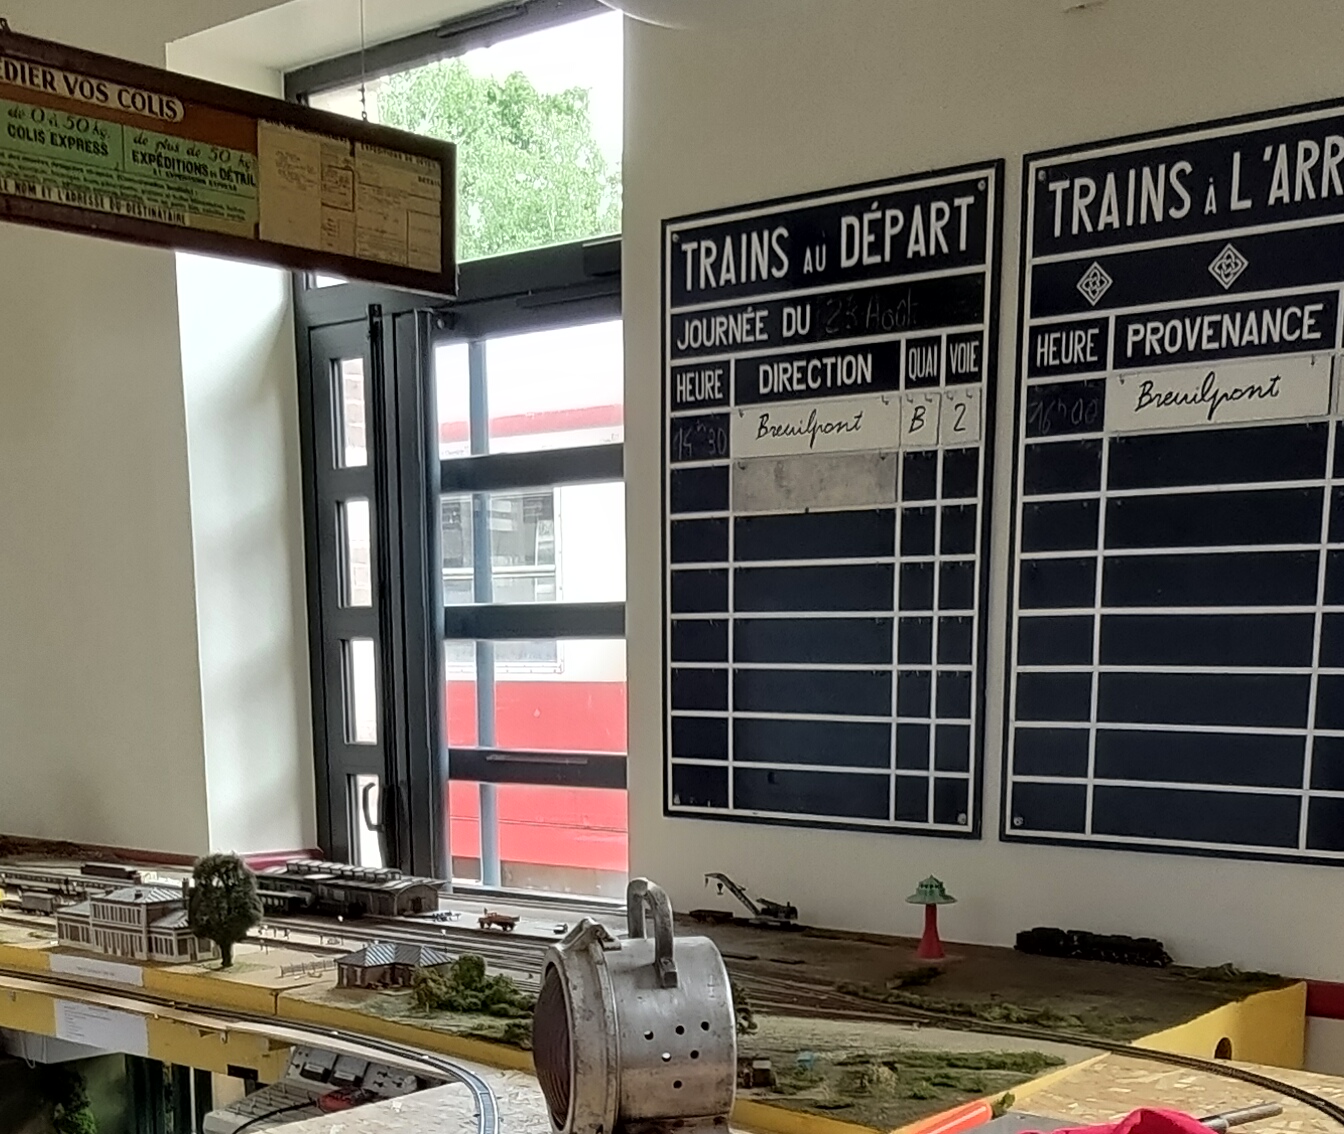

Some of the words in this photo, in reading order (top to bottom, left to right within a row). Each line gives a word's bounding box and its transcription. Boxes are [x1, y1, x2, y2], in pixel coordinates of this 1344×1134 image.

[62, 74, 108, 103] VOS
[117, 88, 177, 119] COLIS
[8, 122, 45, 144] COLIS
[51, 132, 108, 156] EXPRESS
[63, 116, 89, 133] 50
[133, 132, 148, 145] de
[186, 144, 201, 158] de
[15, 180, 36, 195] NOM
[132, 150, 208, 177] EXPÉDITIONS
[219, 166, 256, 187] DÉTAIL
[1048, 161, 1192, 238] TRAINS
[681, 226, 789, 291] TRAINS
[803, 242, 827, 275] AU
[840, 196, 975, 269] DÉPART
[677, 306, 769, 350] JOURNÉE
[783, 304, 810, 338] DU
[1036, 328, 1099, 367] HEURE
[1126, 304, 1323, 358] PROVENANCE
[676, 369, 723, 403] HEURE
[759, 353, 872, 394] DIRECTION
[908, 345, 938, 381] QUAI
[950, 340, 979, 374] VOIE
[909, 405, 926, 433] B
[953, 403, 967, 432] 2
